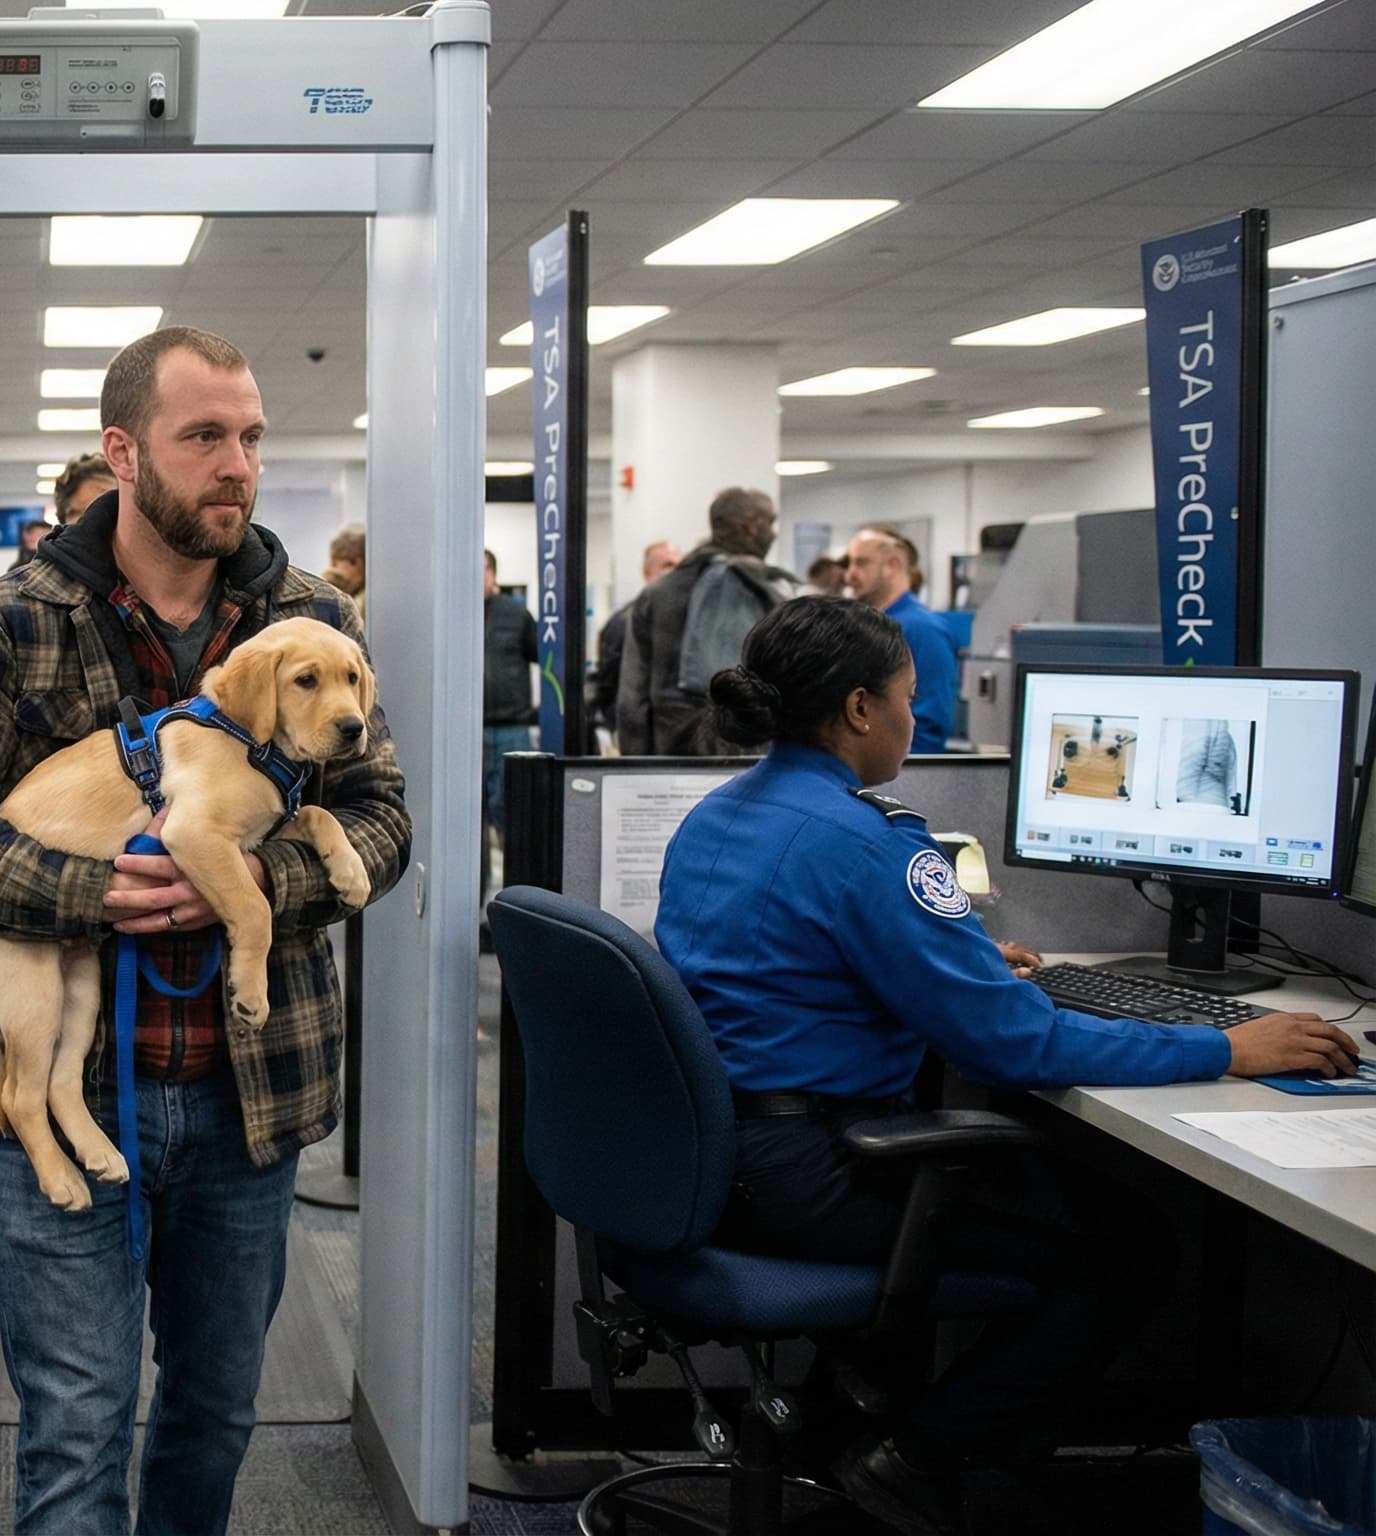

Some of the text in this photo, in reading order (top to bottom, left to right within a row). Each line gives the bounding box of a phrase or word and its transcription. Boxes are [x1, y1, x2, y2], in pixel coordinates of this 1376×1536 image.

[1178, 309, 1214, 408] TSA
[543, 315, 561, 643] TSA PreCheck
[1177, 421, 1214, 647] PreCheck
